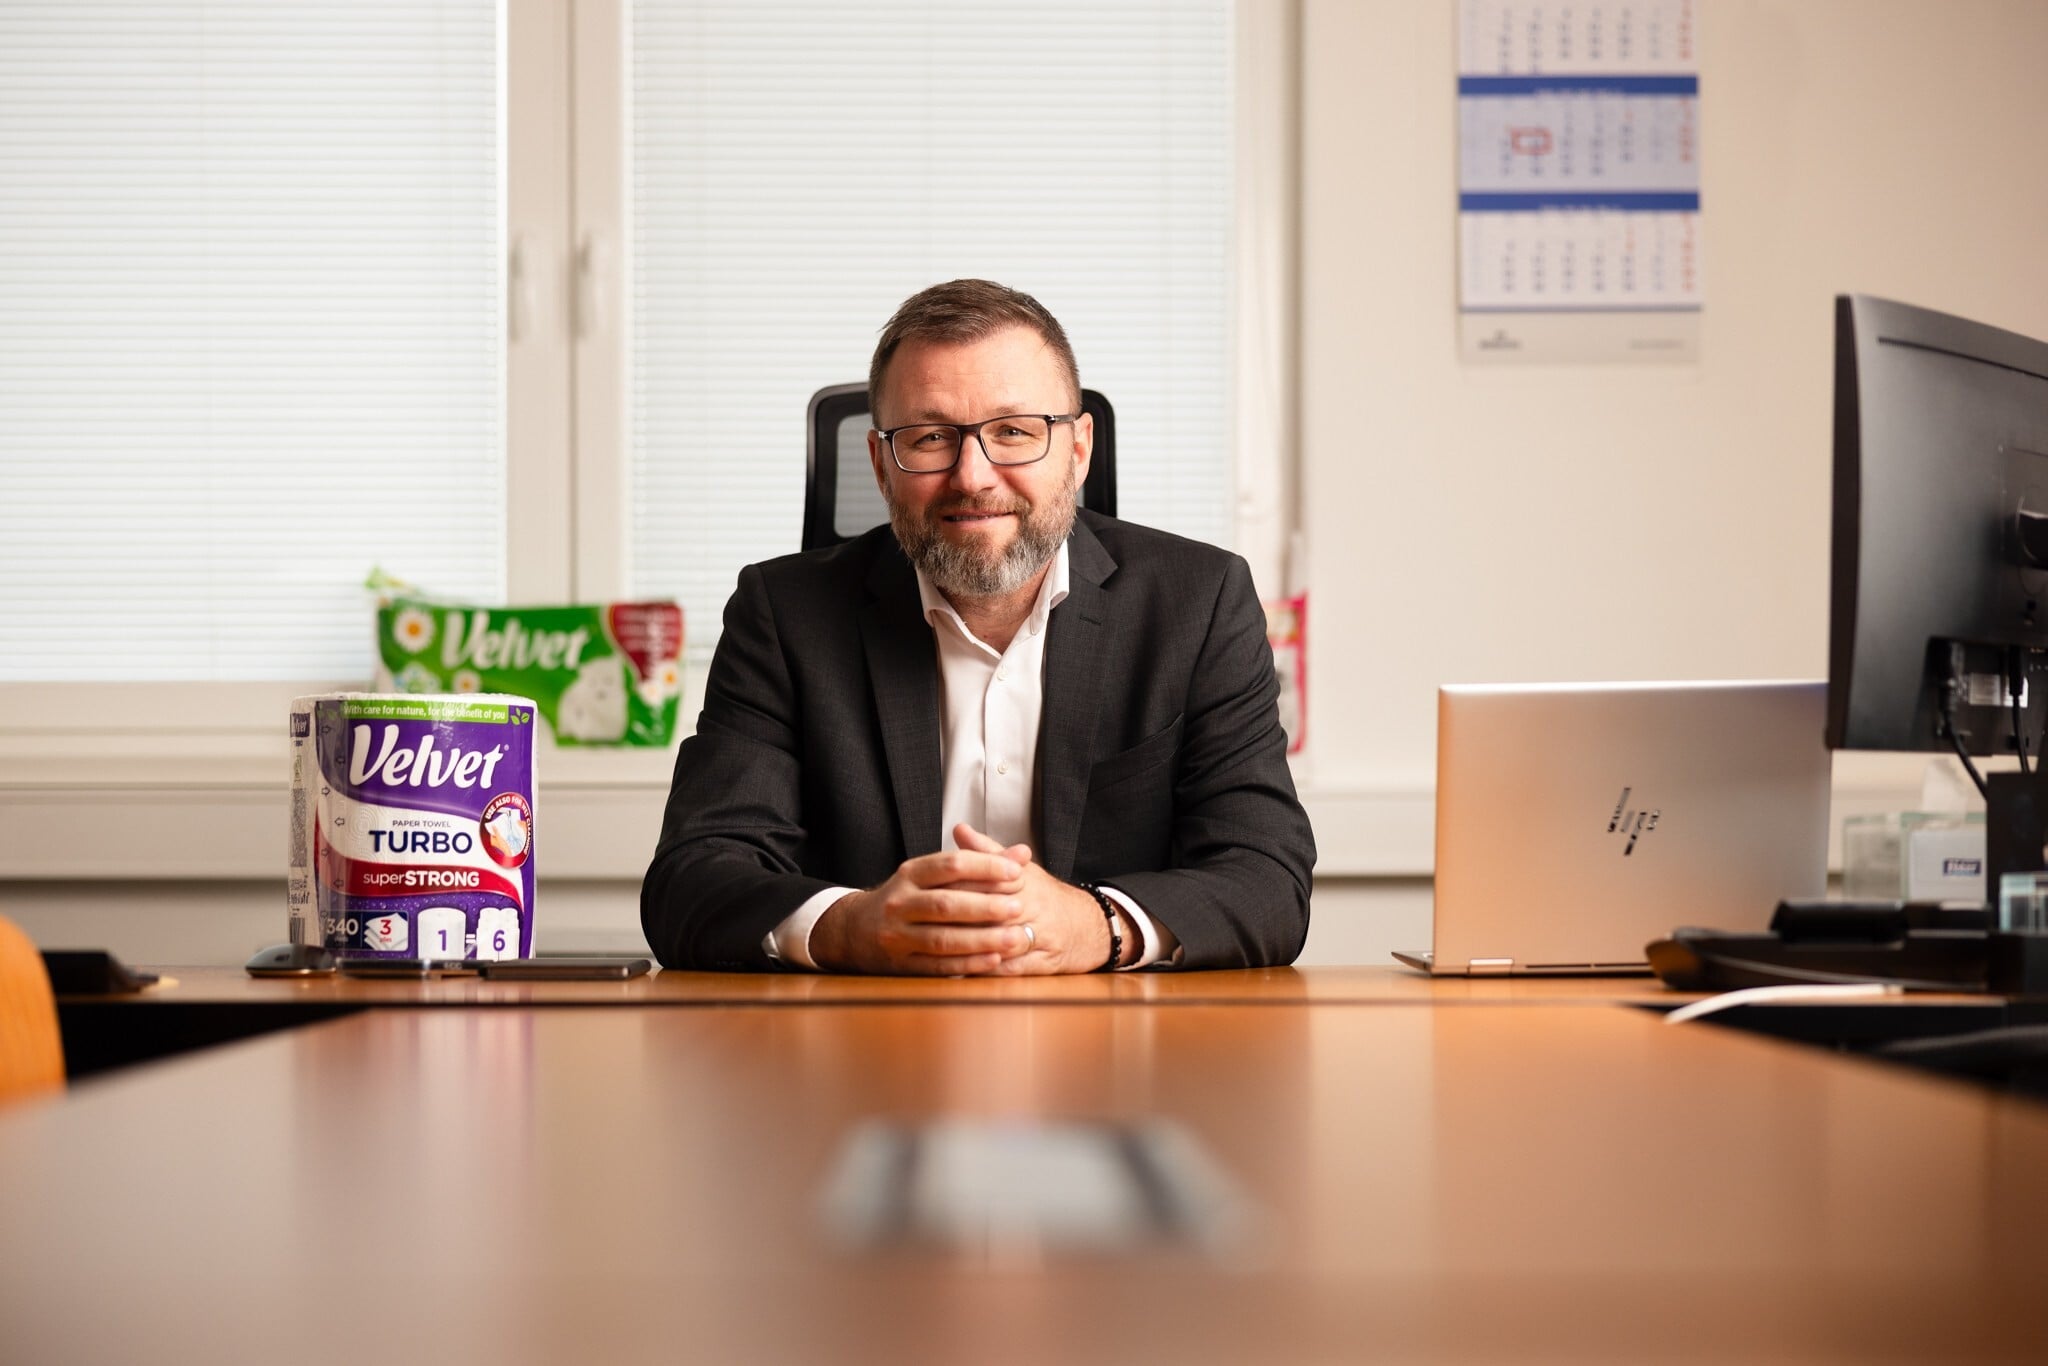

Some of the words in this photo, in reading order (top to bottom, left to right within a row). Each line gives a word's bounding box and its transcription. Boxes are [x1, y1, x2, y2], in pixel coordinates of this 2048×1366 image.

[442, 610, 589, 669] Velvet
[344, 702, 362, 715] With
[363, 706, 381, 715] care
[382, 704, 394, 715] for
[396, 705, 427, 717] nature,
[428, 704, 441, 716] for
[457, 706, 483, 718] benefit
[483, 709, 492, 719] of
[492, 710, 506, 720] you
[349, 724, 504, 789] Velvet
[485, 804, 497, 819] USE
[495, 796, 511, 808] ALSO
[511, 796, 523, 807] FOR
[422, 820, 451, 828] TOWEL
[368, 830, 473, 854] TURBO
[327, 918, 359, 936] 340
[380, 919, 392, 936] 3
[438, 929, 446, 952] 1
[493, 929, 506, 952] 6
